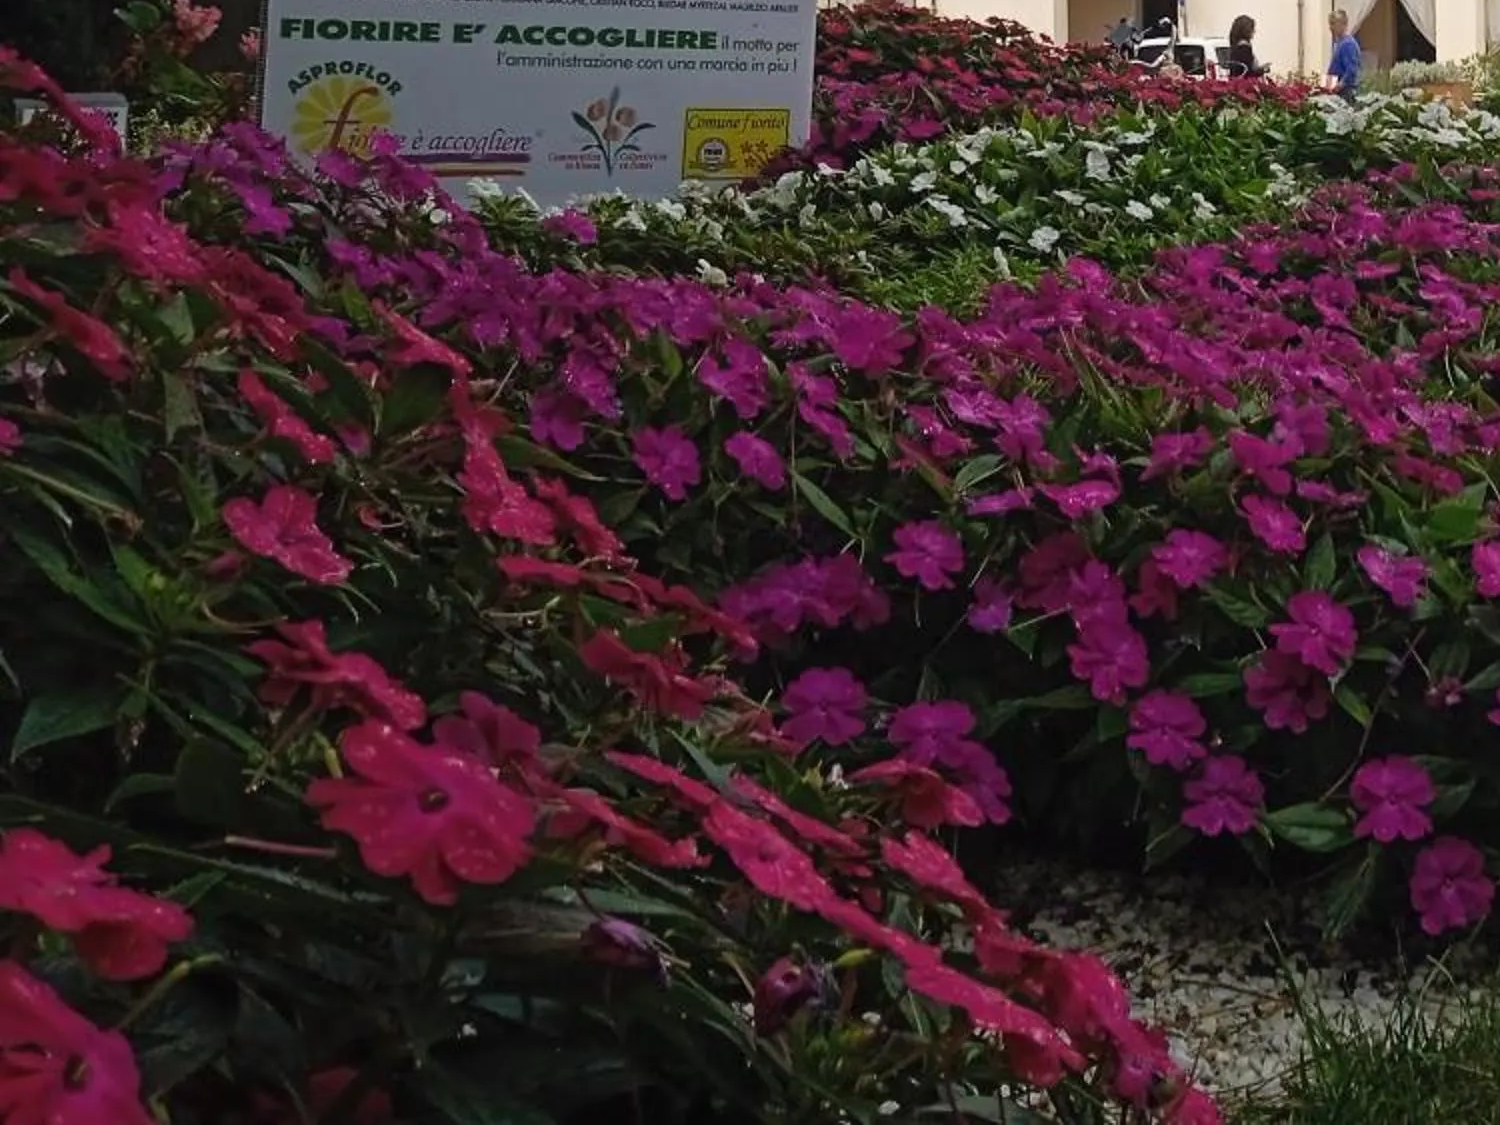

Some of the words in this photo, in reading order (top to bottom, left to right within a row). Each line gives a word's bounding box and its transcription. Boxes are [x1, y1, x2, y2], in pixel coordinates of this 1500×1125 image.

[279, 17, 441, 43] FIORIRE
[493, 24, 717, 49] ACCOGLIERE
[720, 34, 729, 50] il
[731, 38, 773, 52] motto
[775, 41, 799, 55] per
[496, 49, 634, 70] l'amministrazione
[635, 57, 663, 70] con
[666, 59, 696, 71] una
[698, 56, 747, 72] marcia
[750, 57, 765, 72] in
[287, 60, 402, 96] ASPROFLOR
[411, 129, 424, 150] è
[428, 127, 532, 156] accogliere
